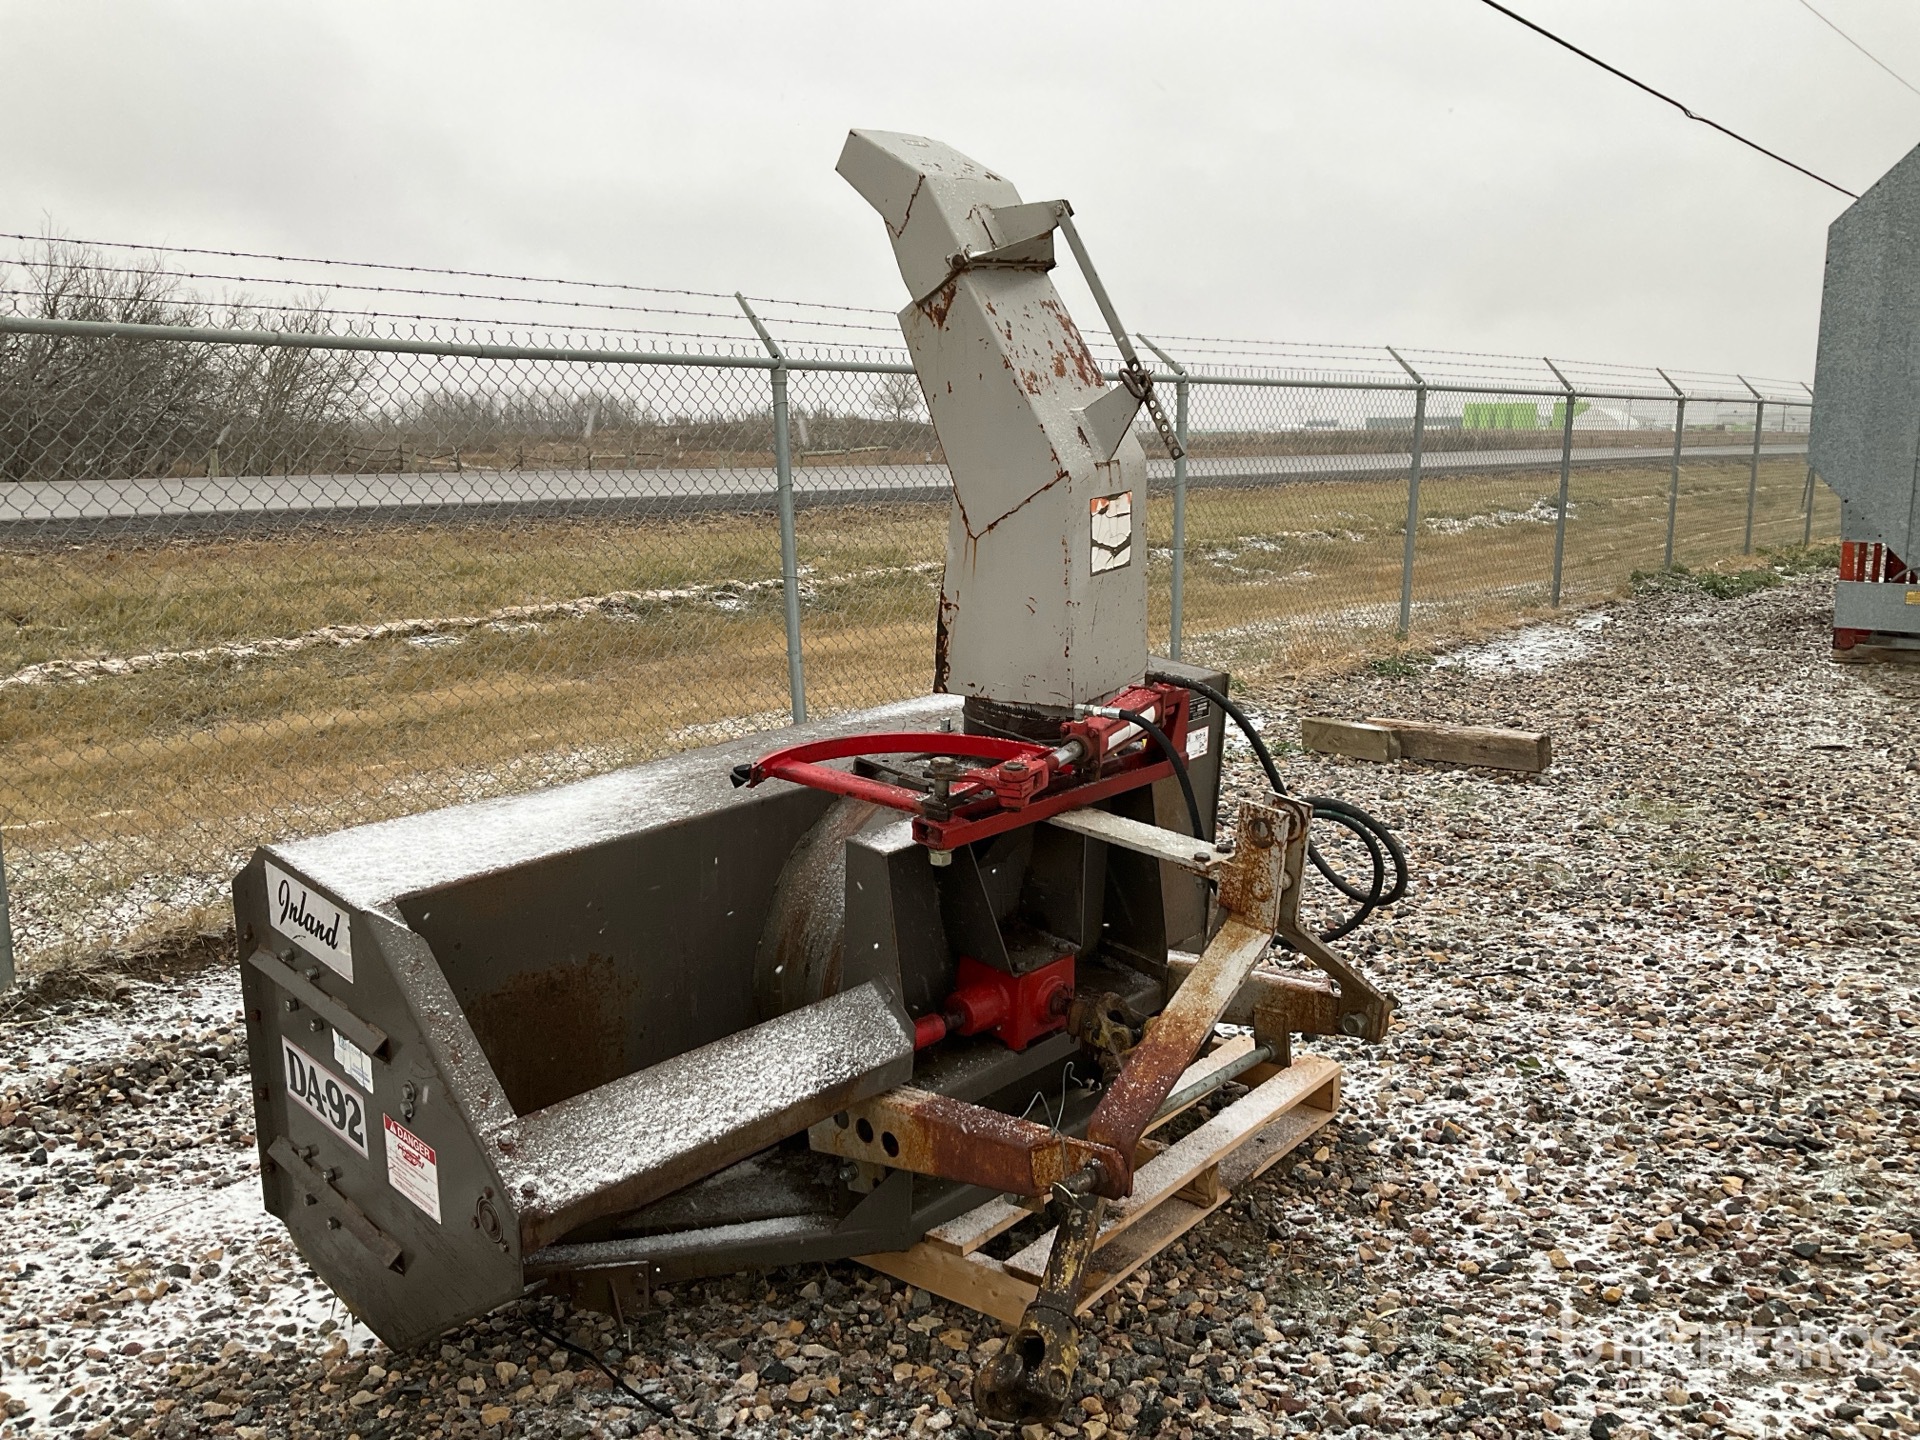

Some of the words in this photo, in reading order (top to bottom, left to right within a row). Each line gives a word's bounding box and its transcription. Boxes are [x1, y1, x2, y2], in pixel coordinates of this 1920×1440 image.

[278, 879, 341, 950] Inland
[286, 1046, 365, 1149] DA-92
[397, 1126, 431, 1160] DANGER
